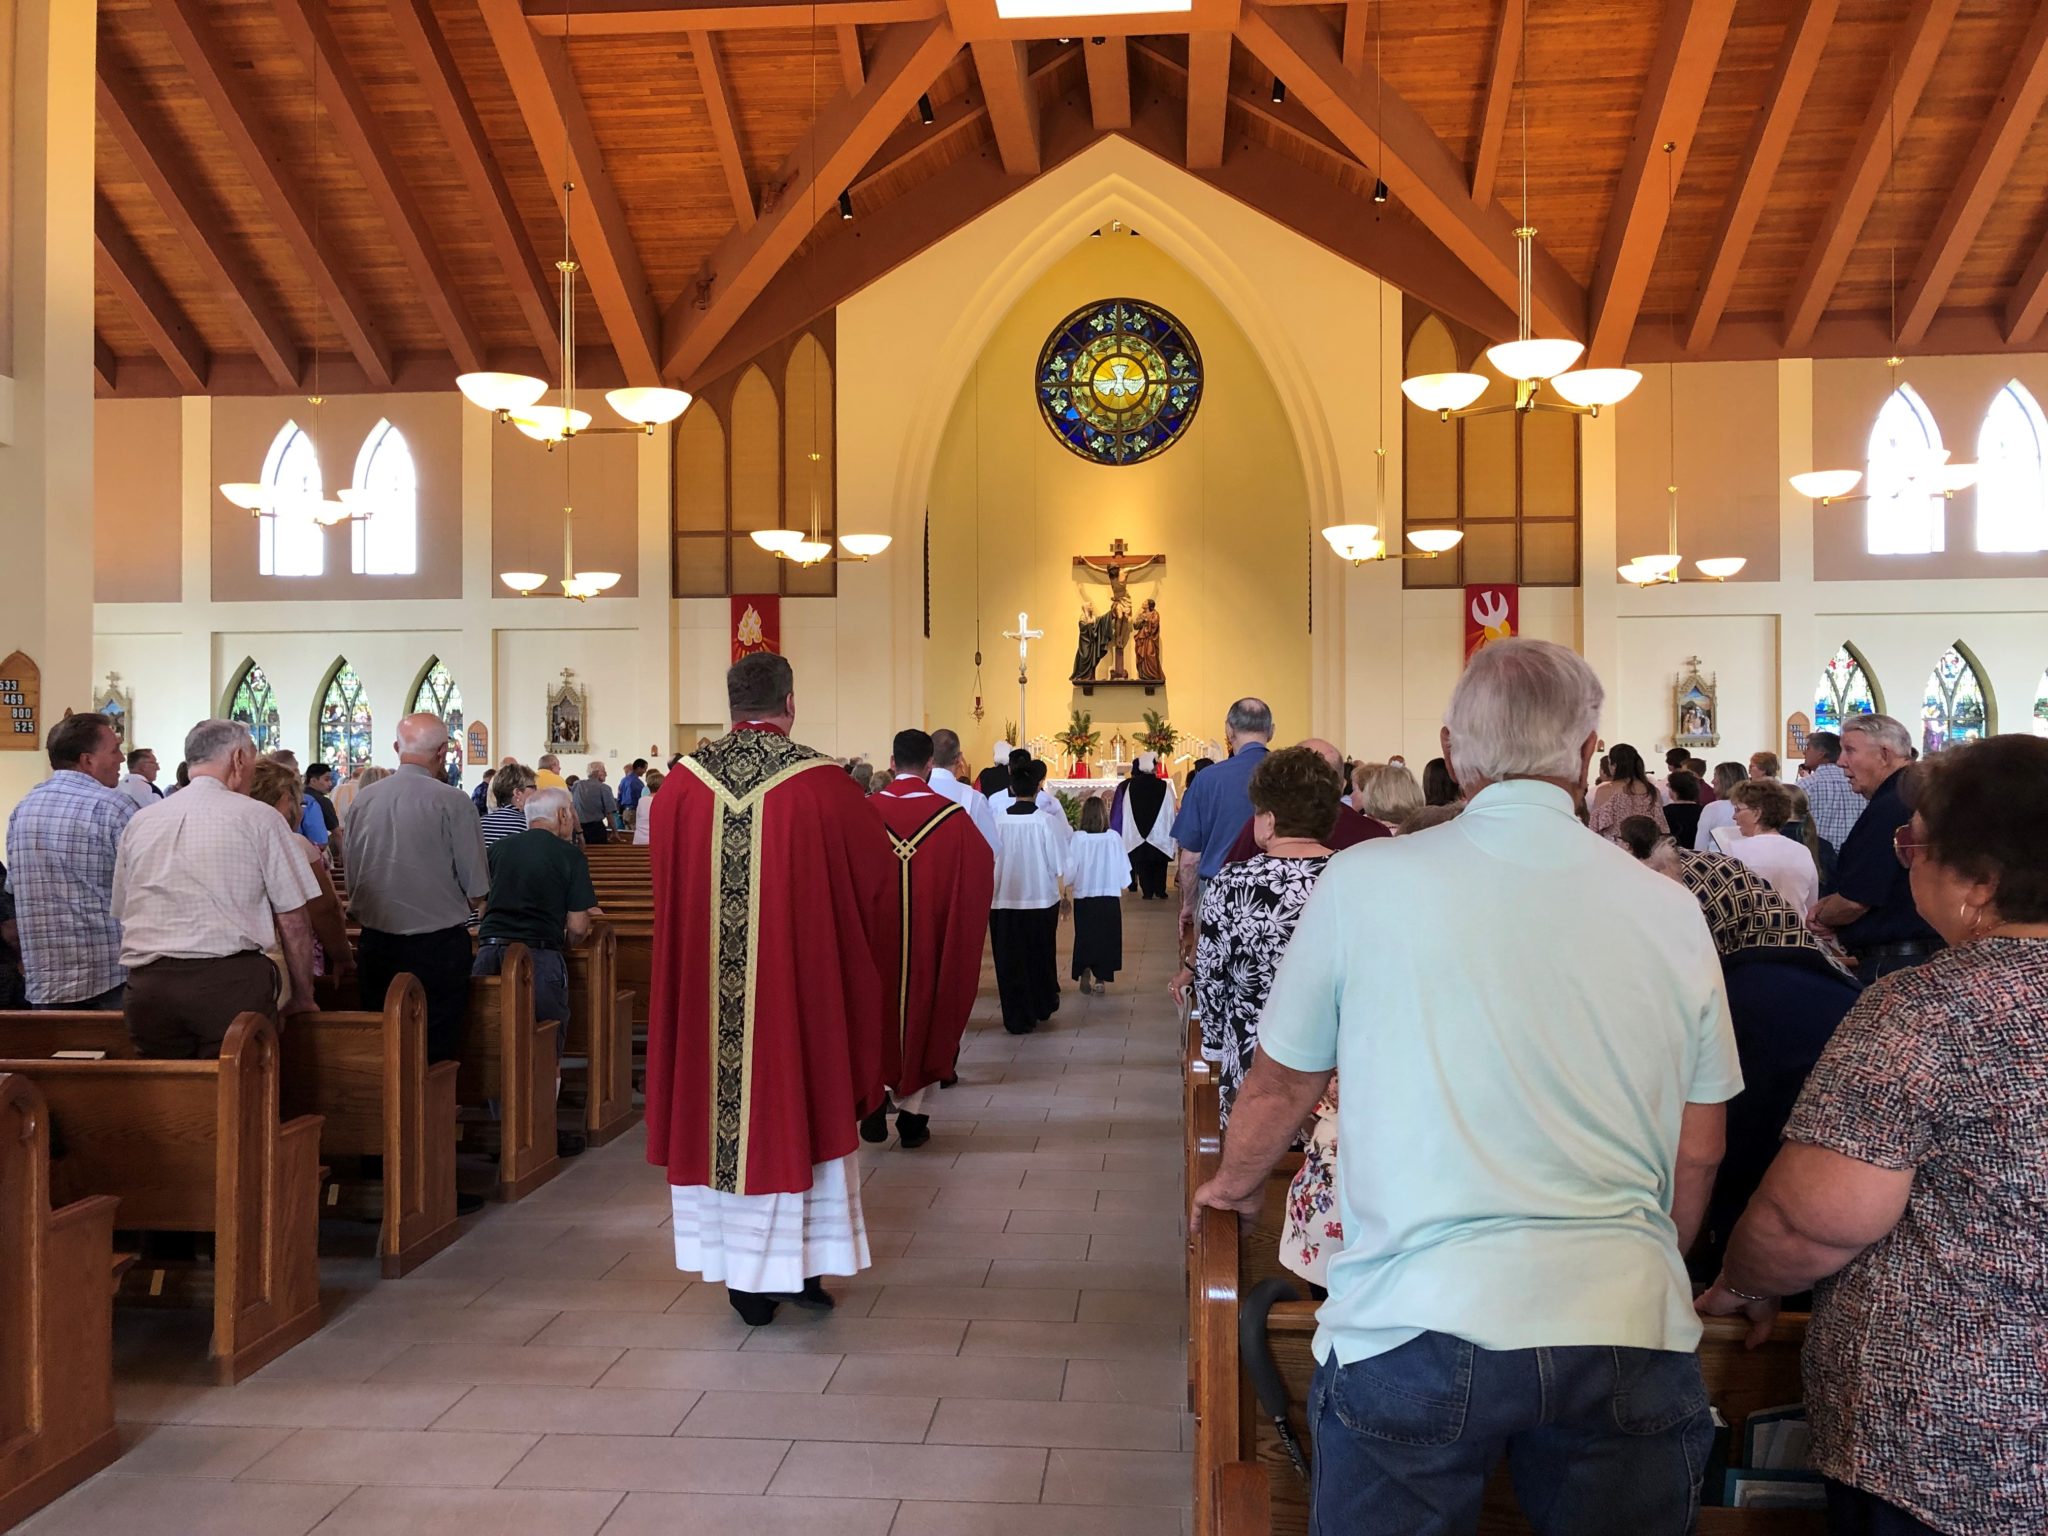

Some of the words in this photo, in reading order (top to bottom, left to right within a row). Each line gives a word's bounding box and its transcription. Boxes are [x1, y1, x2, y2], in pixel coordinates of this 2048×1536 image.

[4, 694, 23, 704] 469
[12, 708, 31, 718] 800
[15, 722, 34, 732] 525
